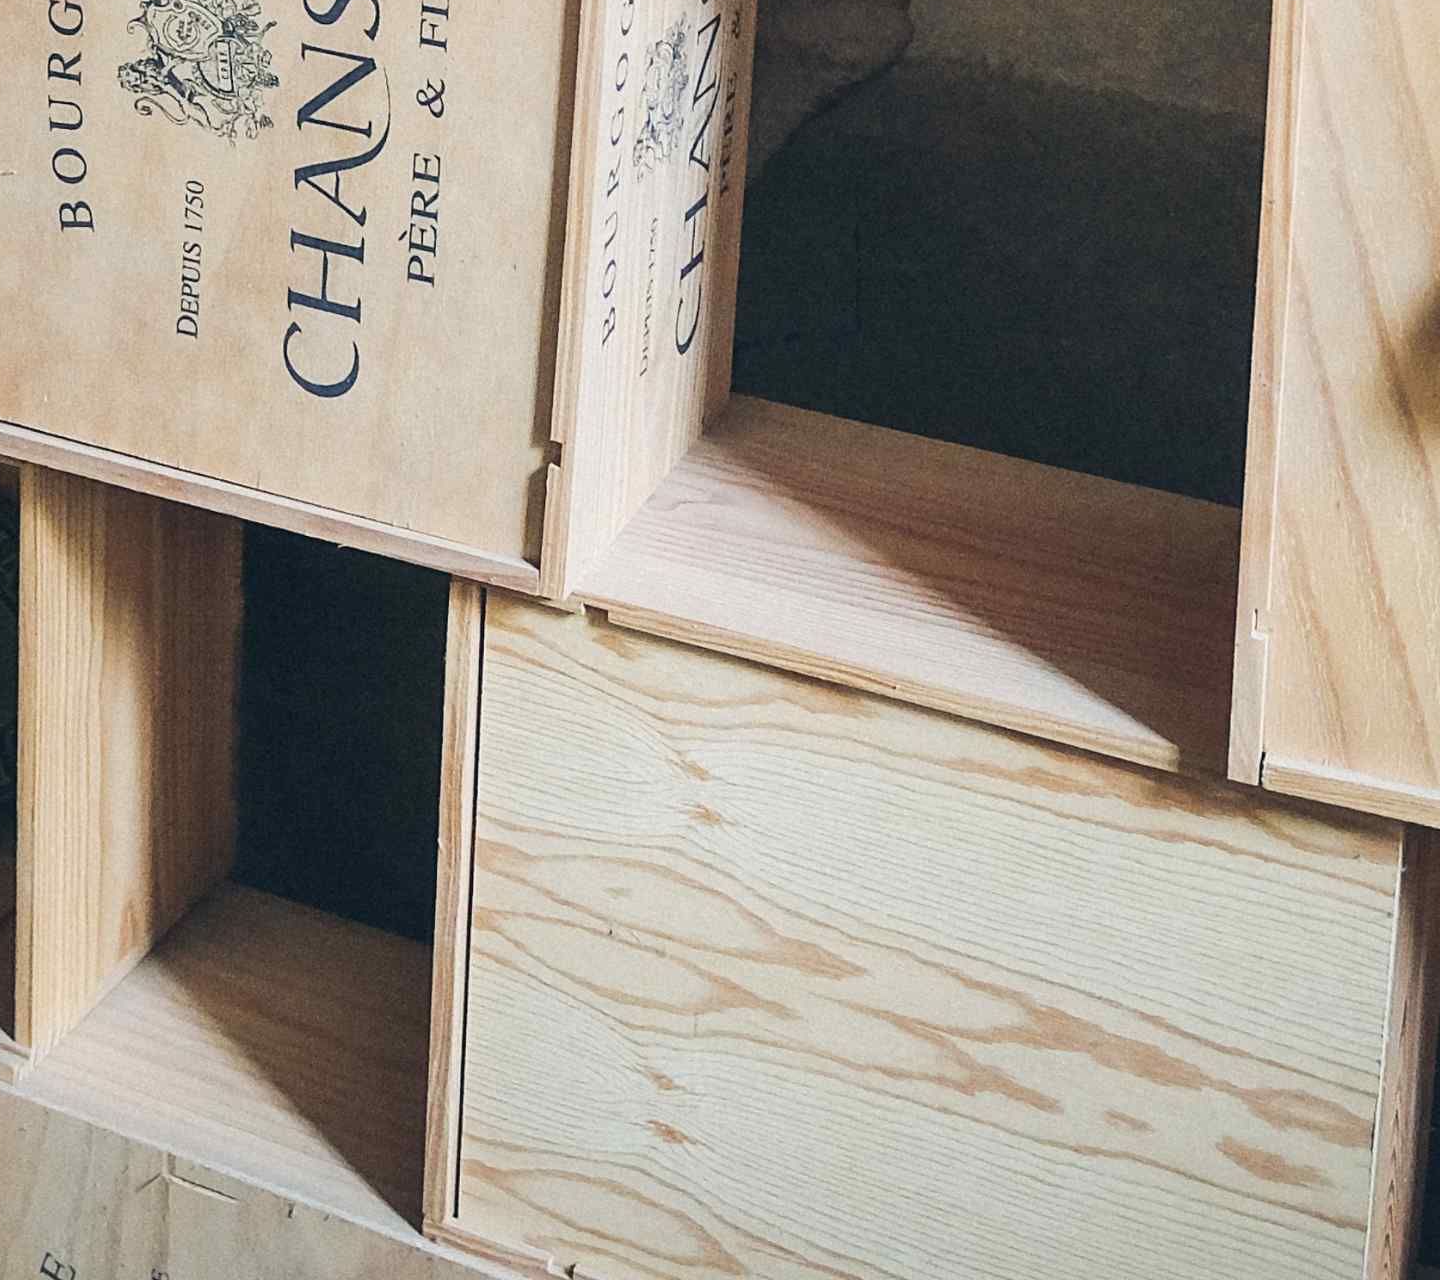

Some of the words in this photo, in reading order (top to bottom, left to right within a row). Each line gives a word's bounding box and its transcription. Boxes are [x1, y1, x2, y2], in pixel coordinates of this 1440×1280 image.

[416, 77, 448, 119] &
[181, 178, 207, 234] 1750
[400, 152, 442, 288] PÈRE
[174, 239, 204, 340] DEPUIS
